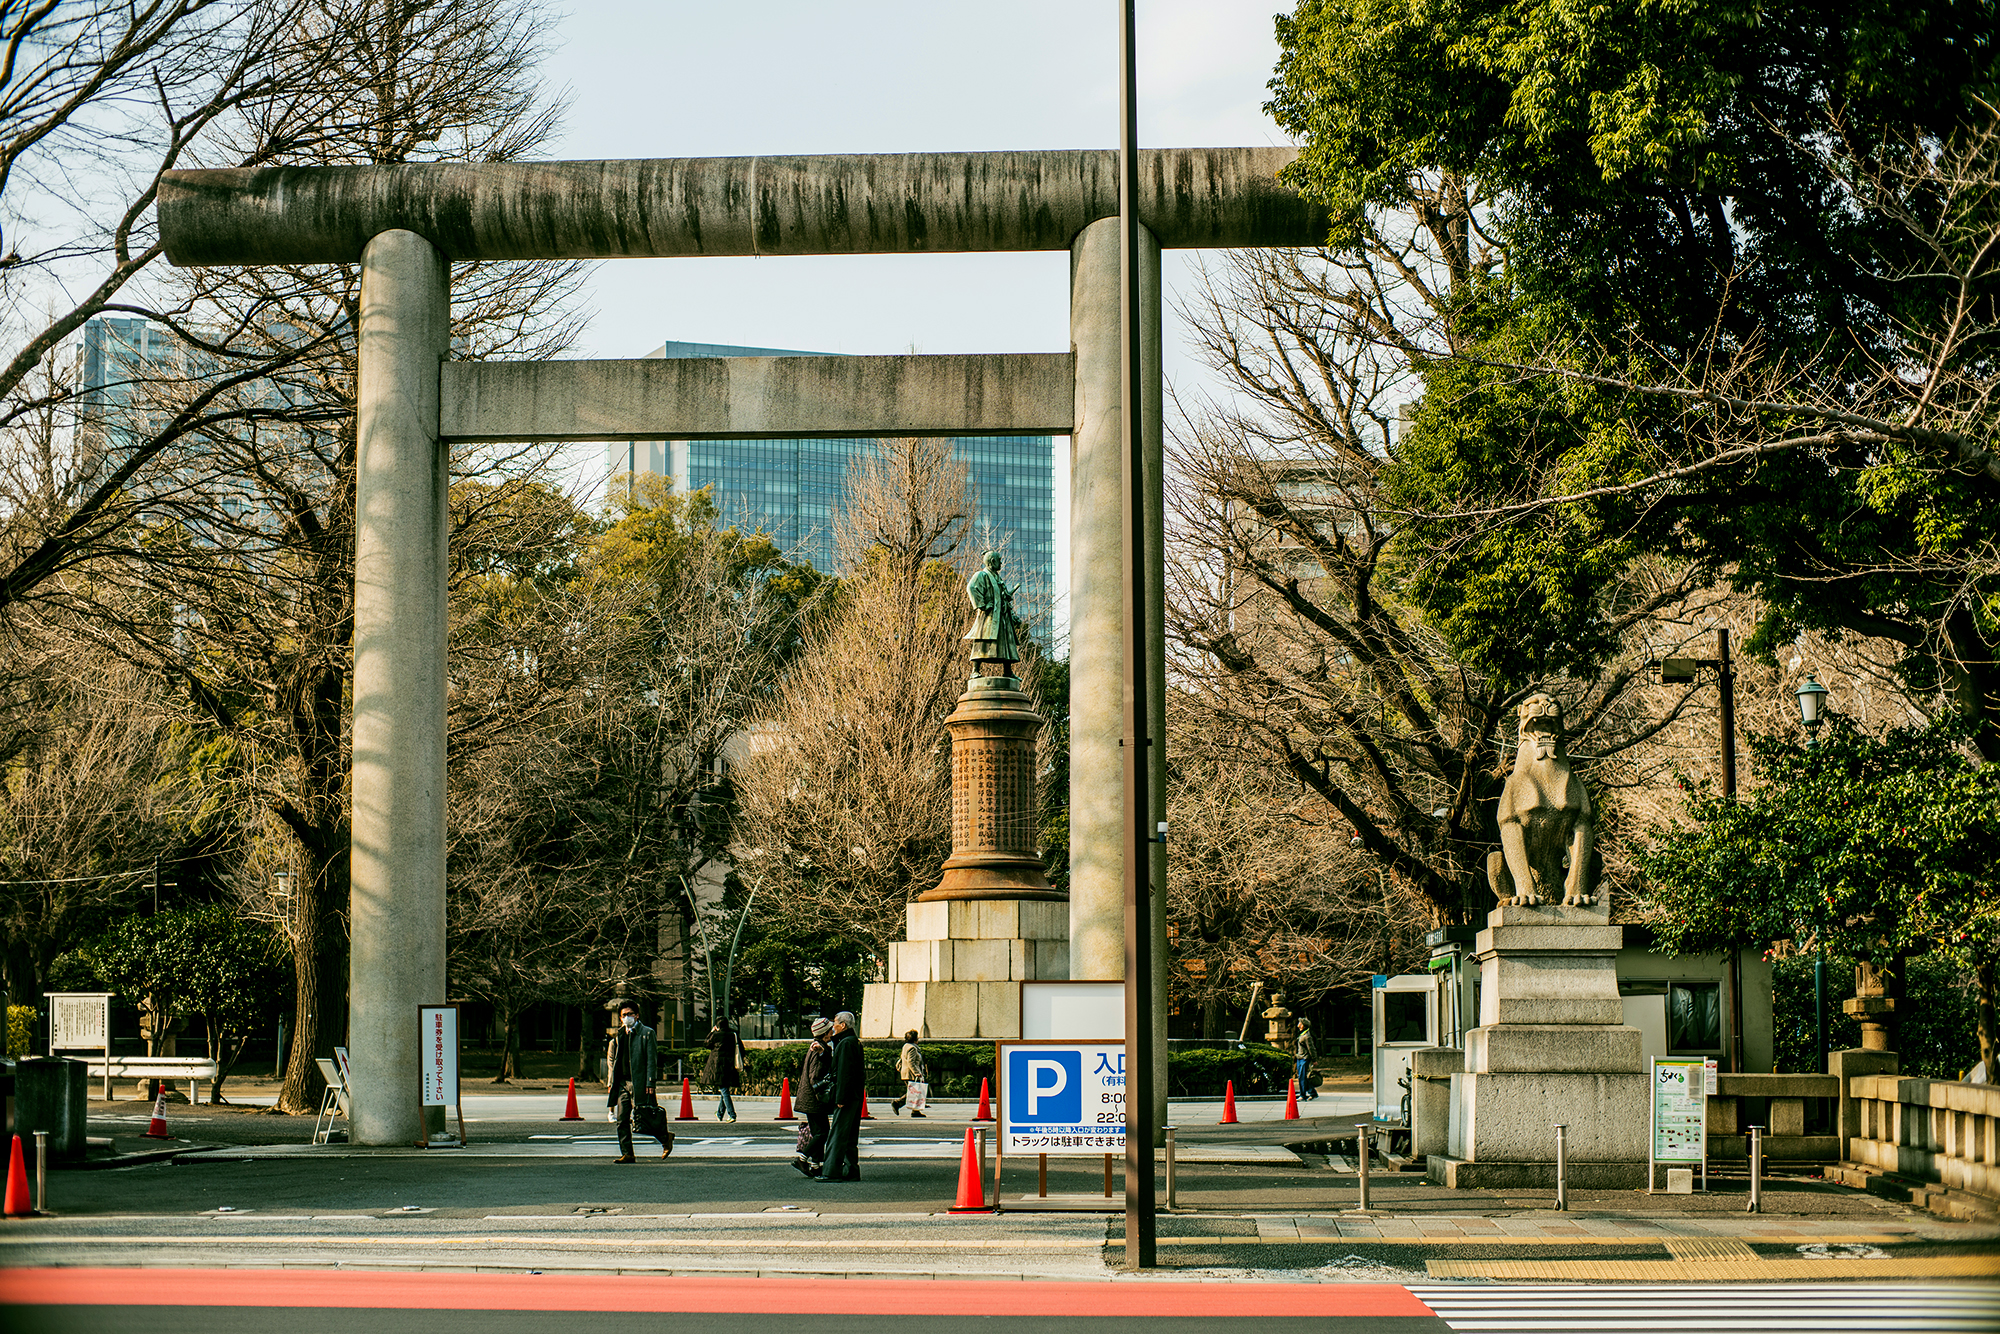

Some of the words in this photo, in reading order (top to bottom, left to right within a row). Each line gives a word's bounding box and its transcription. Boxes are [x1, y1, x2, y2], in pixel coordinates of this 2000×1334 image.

[434, 1013, 444, 1101] 駐車券を受け取って下さい
[1028, 1060, 1068, 1116] P
